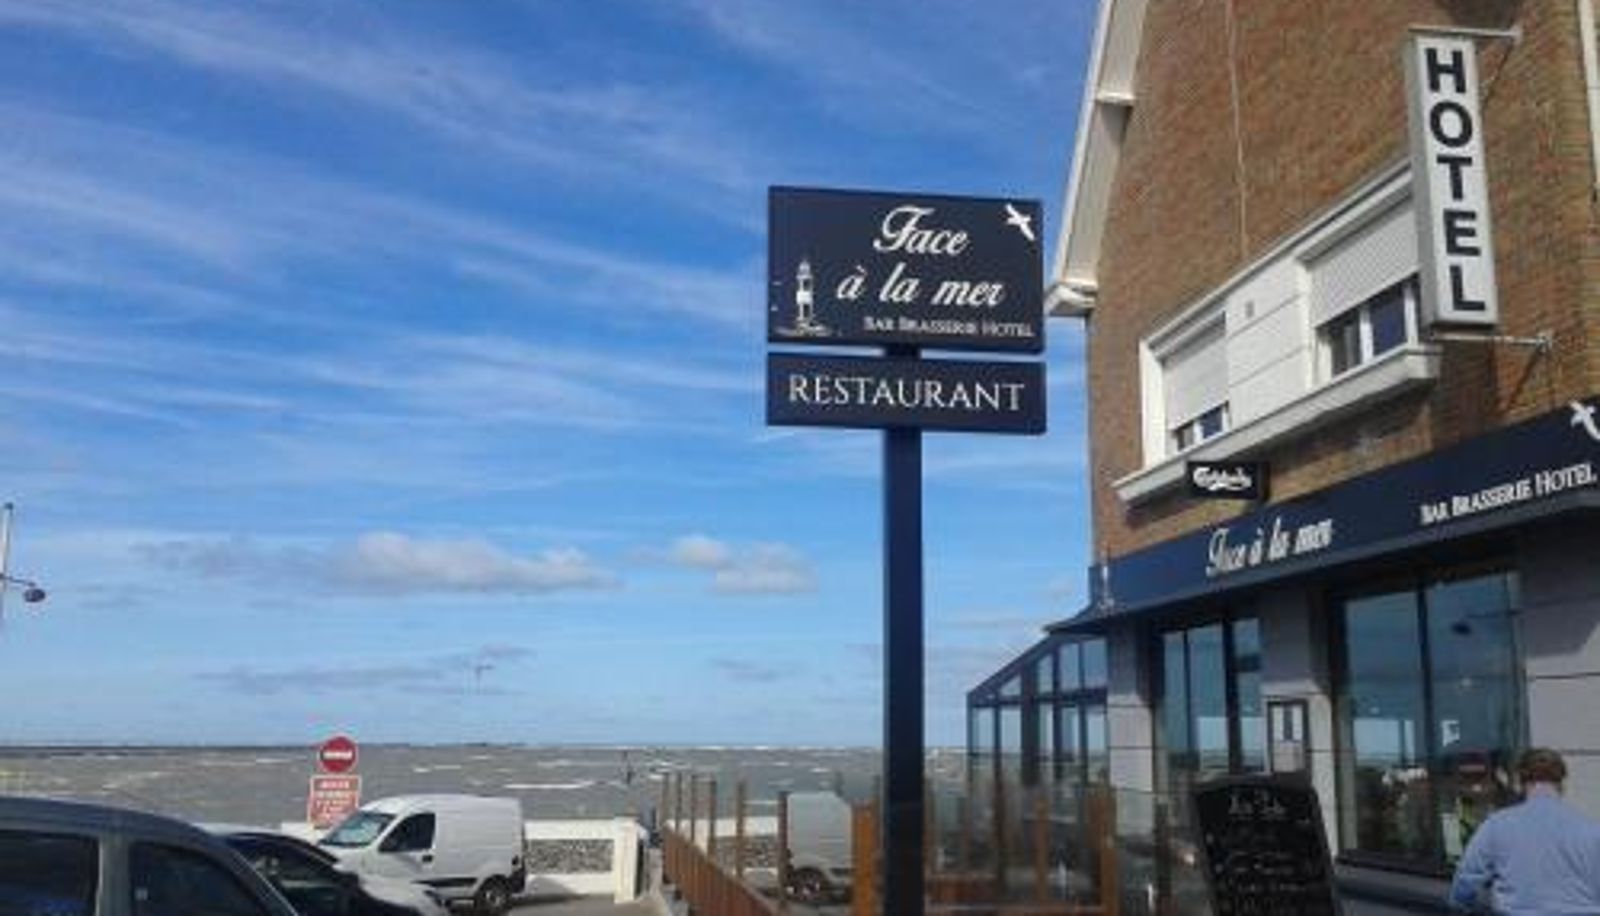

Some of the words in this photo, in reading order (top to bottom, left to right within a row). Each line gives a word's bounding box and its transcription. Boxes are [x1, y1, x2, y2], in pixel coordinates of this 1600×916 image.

[1425, 47, 1486, 311] HOTEL
[873, 205, 968, 254] Face
[837, 266, 867, 300] à
[879, 262, 920, 302] la
[931, 282, 1004, 307] mer
[789, 374, 1025, 411] RESTAURANT
